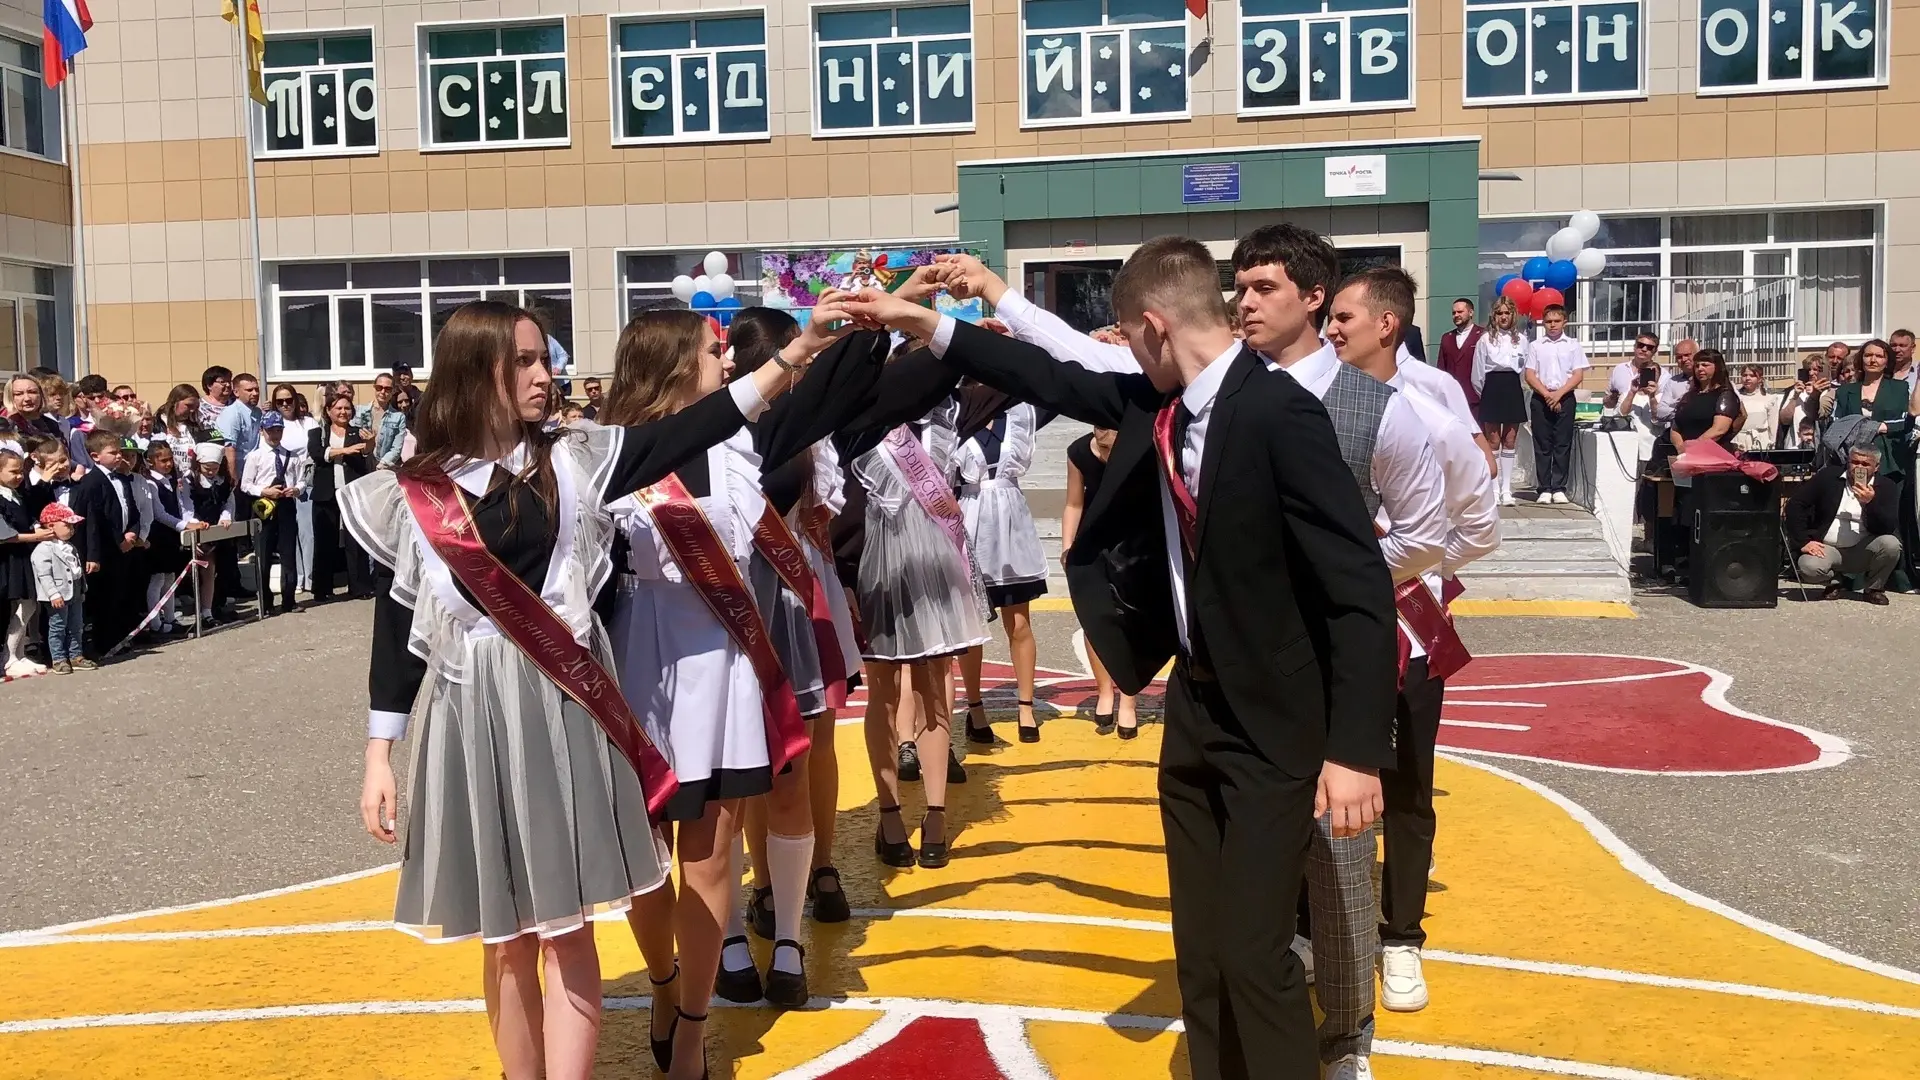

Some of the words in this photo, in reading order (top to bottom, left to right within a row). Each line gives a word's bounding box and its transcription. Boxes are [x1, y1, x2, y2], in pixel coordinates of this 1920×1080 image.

[463, 552, 567, 659] Выпускница
[558, 652, 608, 699] 2026
[665, 502, 733, 604] Выпускница
[726, 600, 760, 645] 2026
[770, 541, 803, 578] 2026
